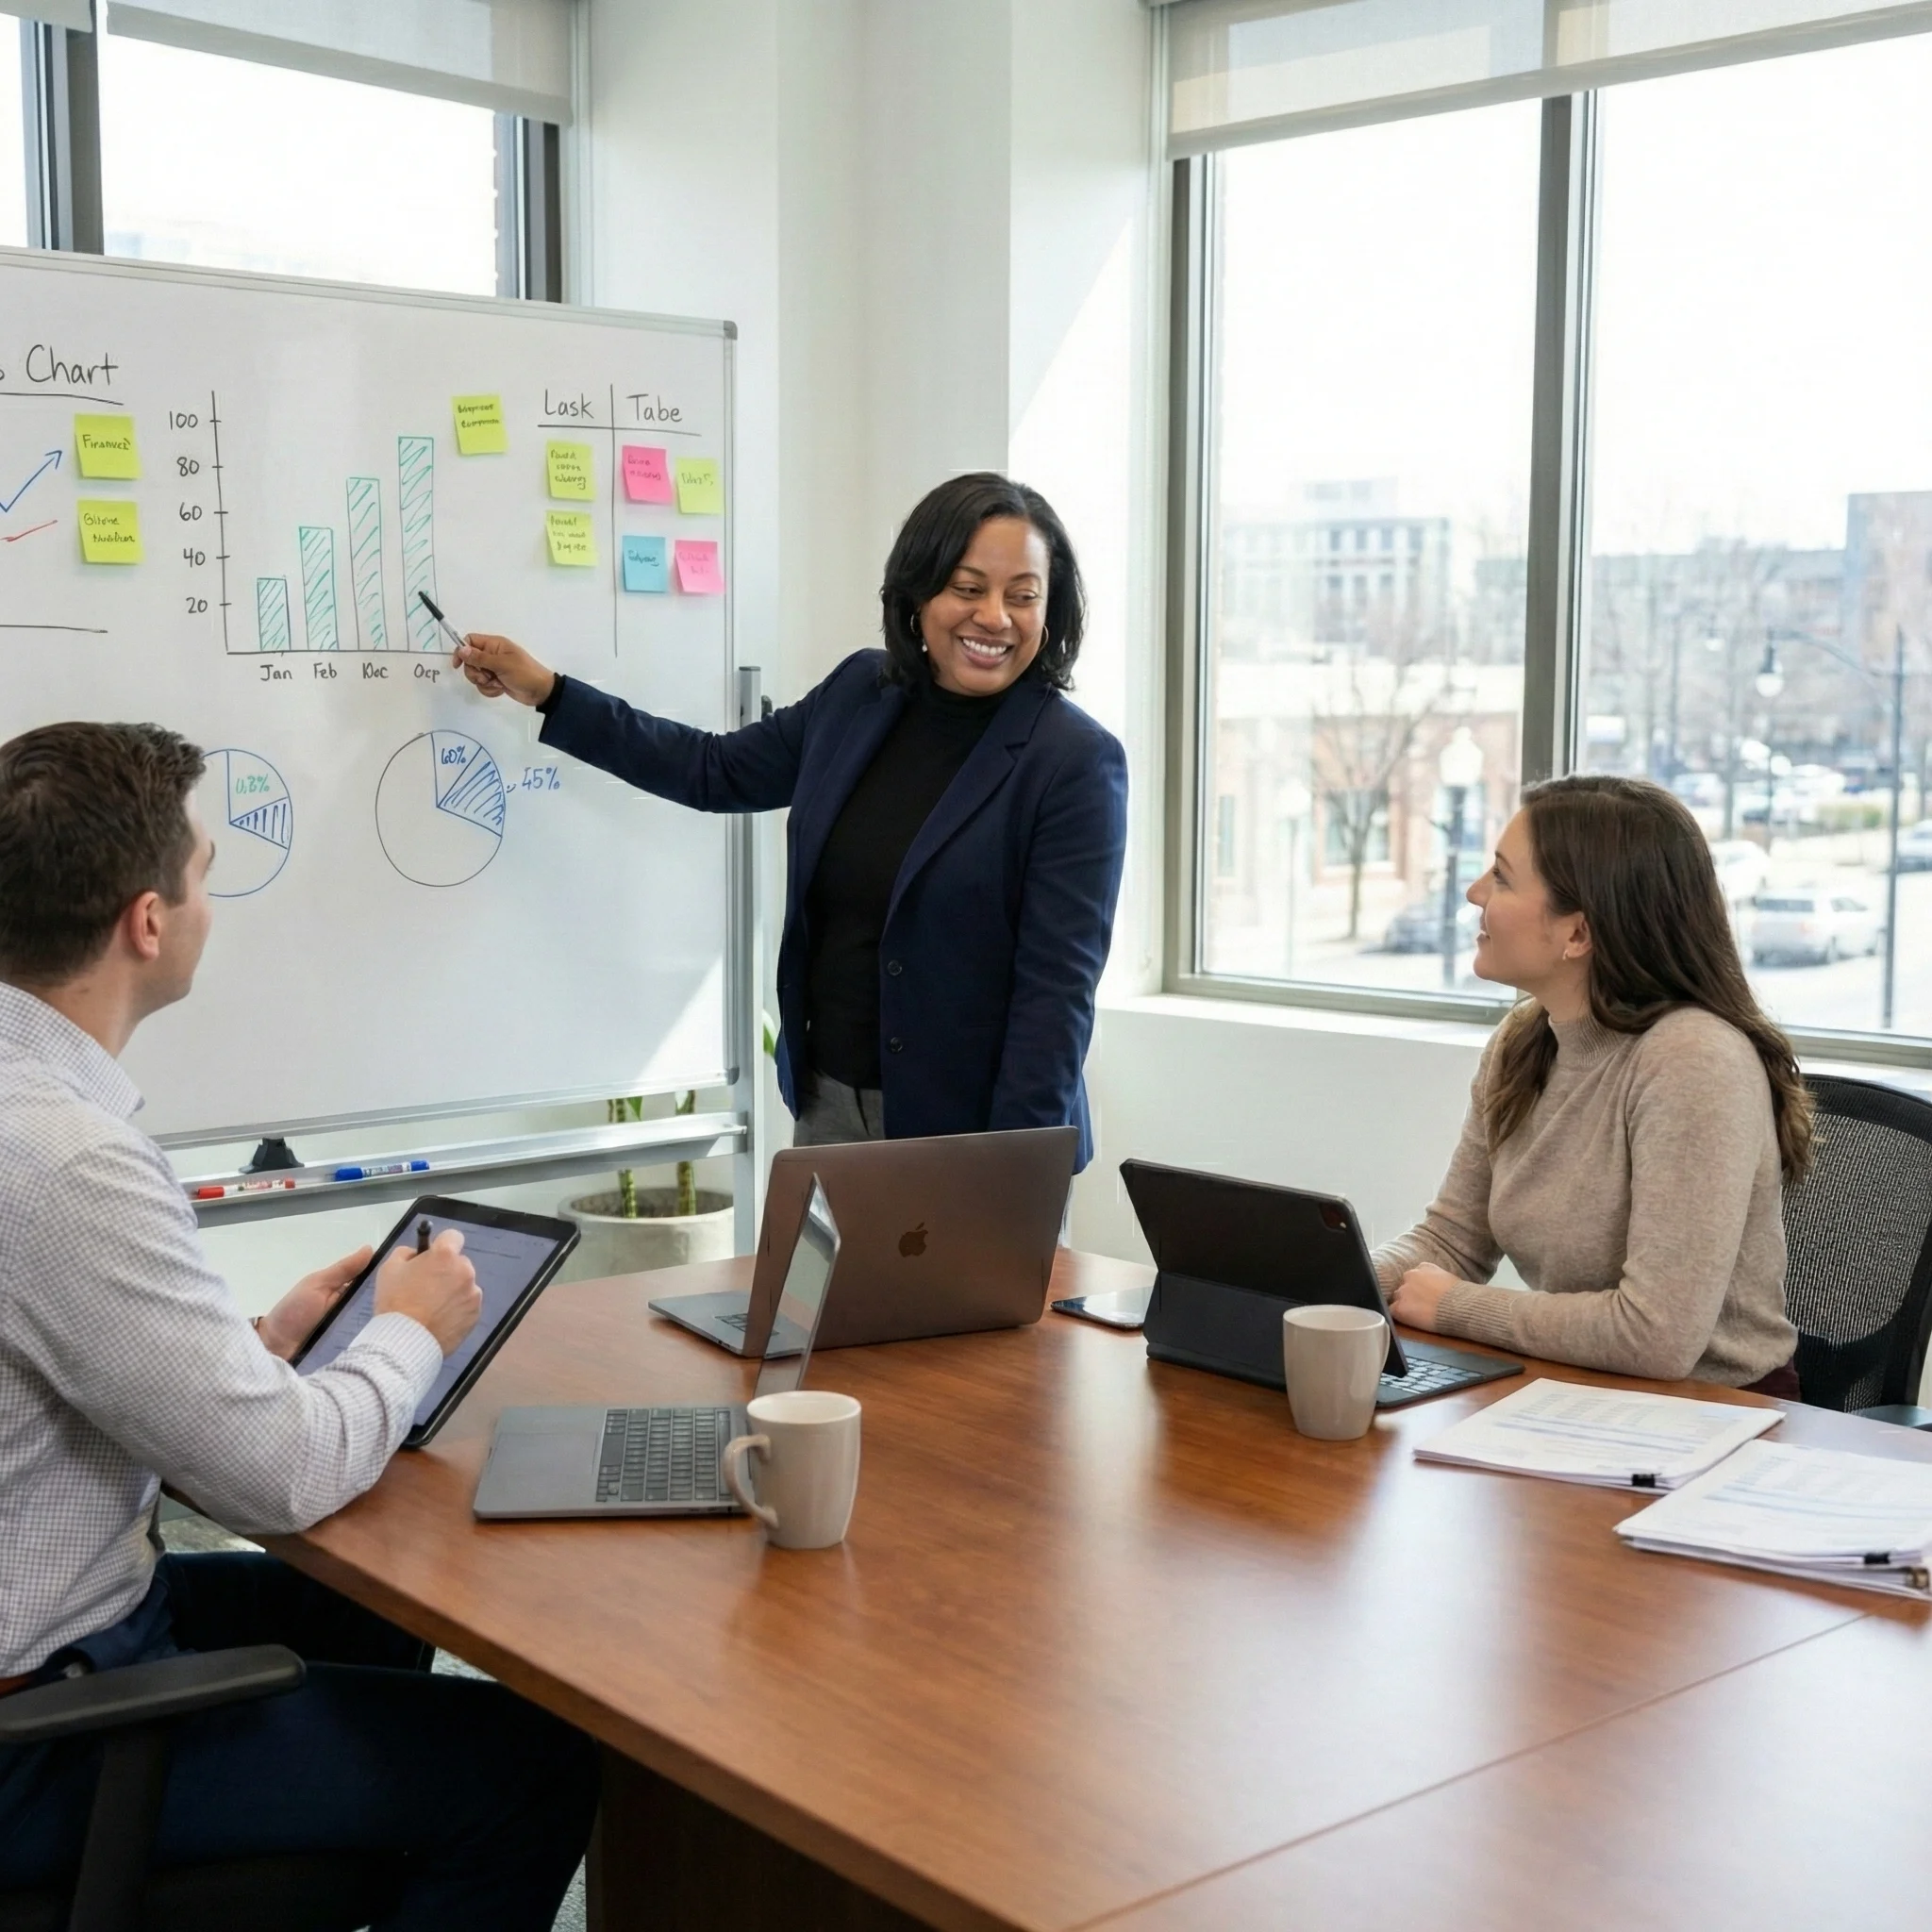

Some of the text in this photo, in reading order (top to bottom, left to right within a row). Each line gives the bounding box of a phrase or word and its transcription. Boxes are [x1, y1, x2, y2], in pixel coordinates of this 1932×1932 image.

[26, 344, 119, 386] Chart
[544, 389, 594, 419] Lask
[626, 393, 682, 422] Tabe
[169, 411, 198, 430] 100
[176, 457, 200, 476] 80
[179, 502, 203, 522] 60
[183, 548, 206, 567] 40
[186, 597, 208, 614] 20
[259, 664, 292, 681] Jan
[313, 662, 338, 679] Feb
[441, 745, 466, 765] 60%
[522, 766, 560, 791] 45%
